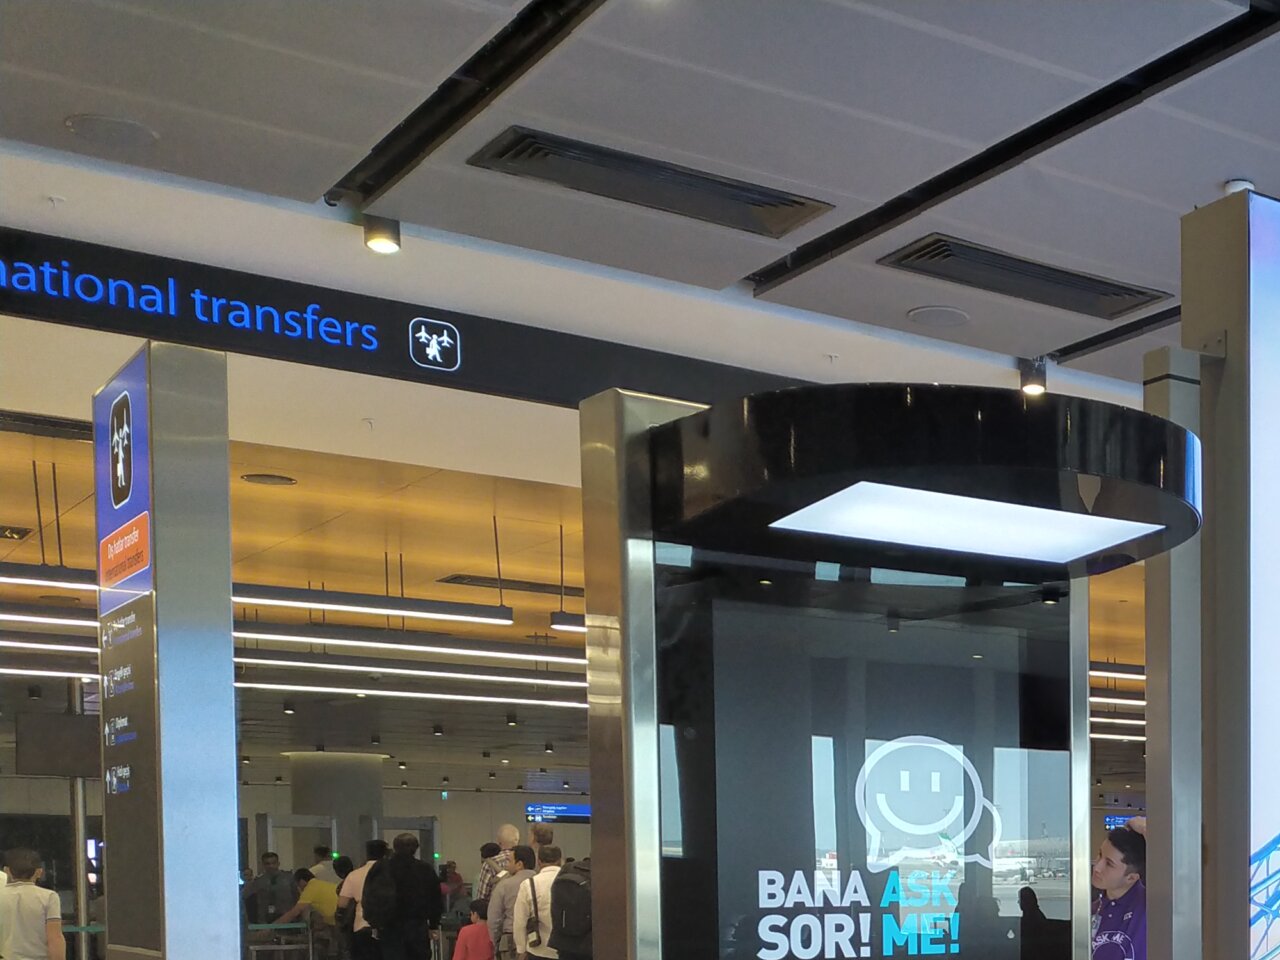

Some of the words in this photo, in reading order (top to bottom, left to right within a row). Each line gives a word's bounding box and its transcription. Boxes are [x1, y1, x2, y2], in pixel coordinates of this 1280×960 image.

[190, 288, 379, 351] transfers
[757, 870, 871, 908] BANA
[880, 869, 958, 907] ASK
[756, 913, 871, 960] SOR!
[882, 912, 960, 956] ME!
[1092, 933, 1109, 949] ASK
